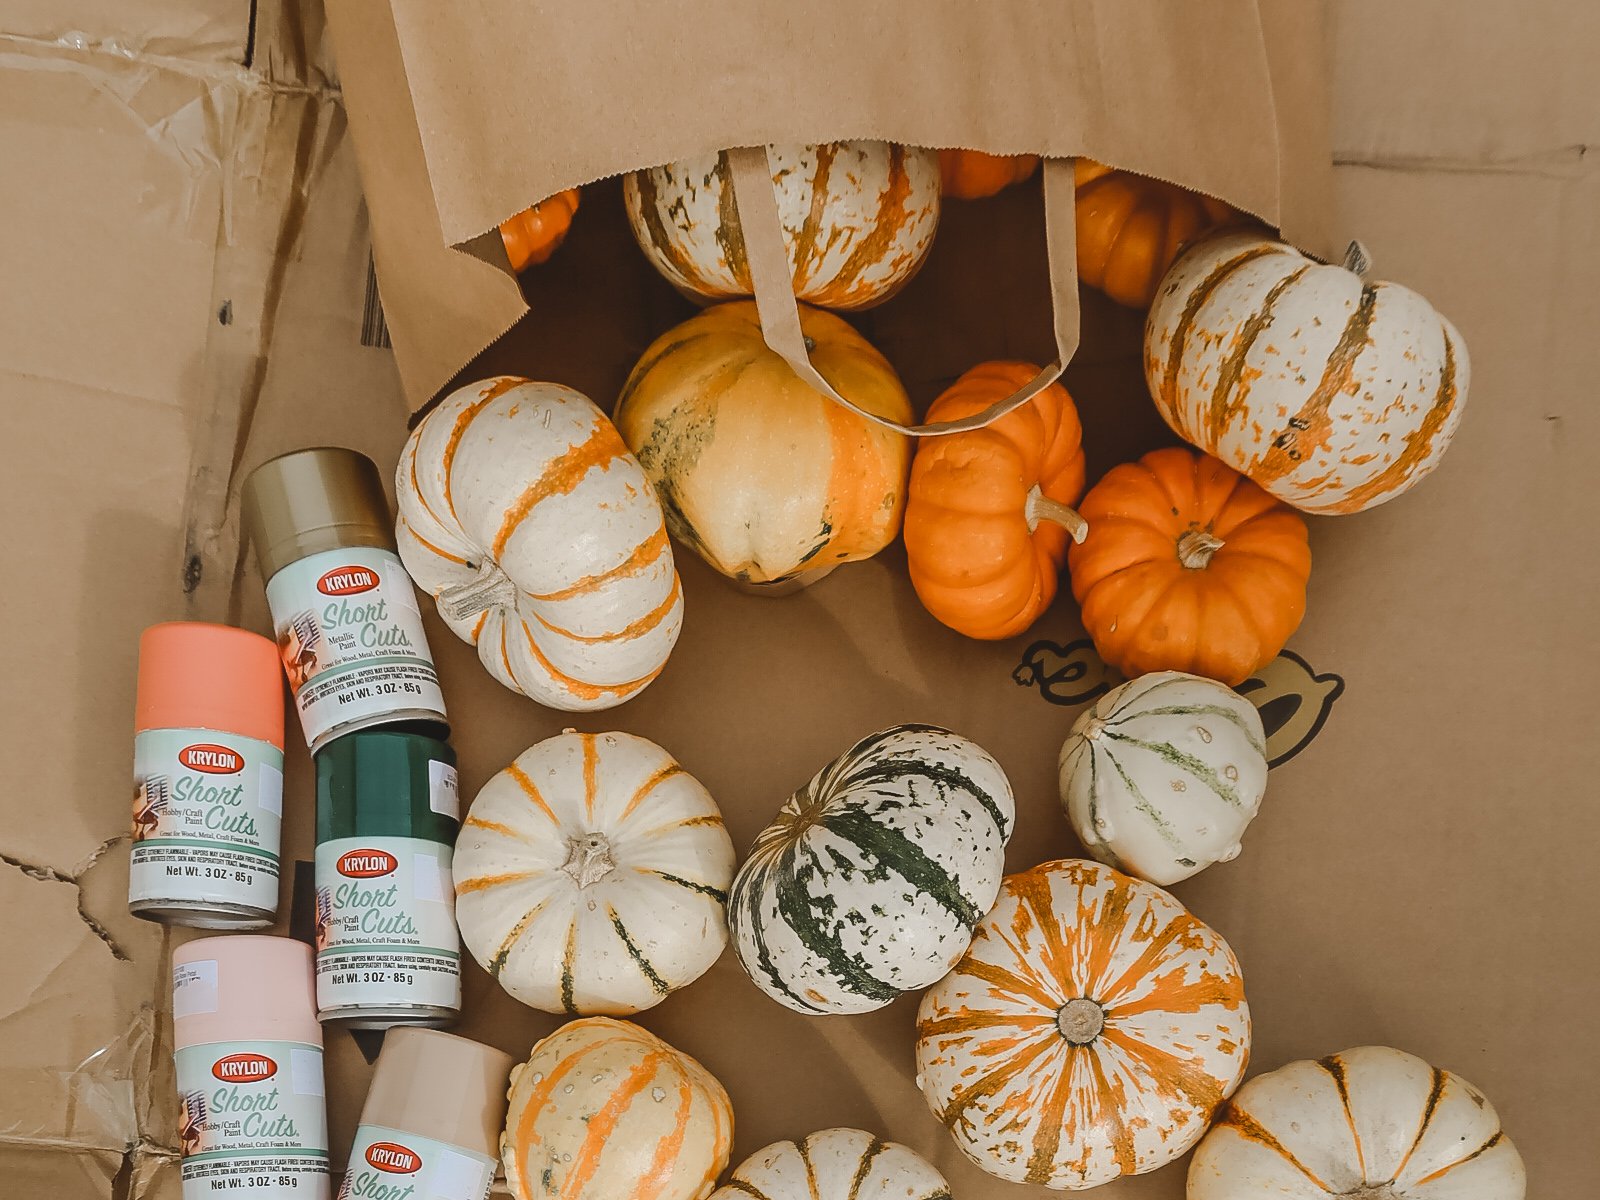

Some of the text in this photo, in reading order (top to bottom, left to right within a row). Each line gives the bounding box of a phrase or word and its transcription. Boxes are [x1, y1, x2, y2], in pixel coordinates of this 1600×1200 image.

[324, 572, 372, 592] KRYLON
[322, 599, 388, 630] Short
[328, 631, 354, 645] Metallic
[339, 640, 356, 650] Paint
[360, 623, 410, 648] Cuts
[338, 692, 355, 705] Net
[356, 688, 374, 699] Wt.
[376, 685, 383, 695] 3
[384, 683, 397, 694] OZ
[188, 750, 236, 769] KRYLON
[171, 775, 244, 807] Short
[162, 808, 203, 817] Hobby/Craft
[185, 817, 203, 825] Paint
[205, 805, 256, 836] Cuts
[166, 866, 182, 876] Net
[185, 866, 202, 877] Wt.
[205, 868, 211, 878] 3
[214, 868, 227, 879] OZ
[344, 857, 388, 872] KRYLON
[333, 881, 398, 909] Short
[361, 908, 416, 934] Cuts
[332, 974, 344, 985] Net
[346, 973, 360, 984] Wt.
[364, 972, 370, 983] 3
[371, 972, 385, 983] OZ
[221, 1061, 268, 1077] KRYLON
[209, 1085, 279, 1114] Short
[202, 1120, 241, 1131] Hobby/Craft
[225, 1129, 241, 1137] Paint
[243, 1112, 297, 1138] Cuts
[370, 1147, 414, 1169] KRYLON
[211, 1180, 226, 1190] Net
[228, 1178, 245, 1188] Wt.
[248, 1177, 254, 1187] 3
[256, 1176, 270, 1187] OZ
